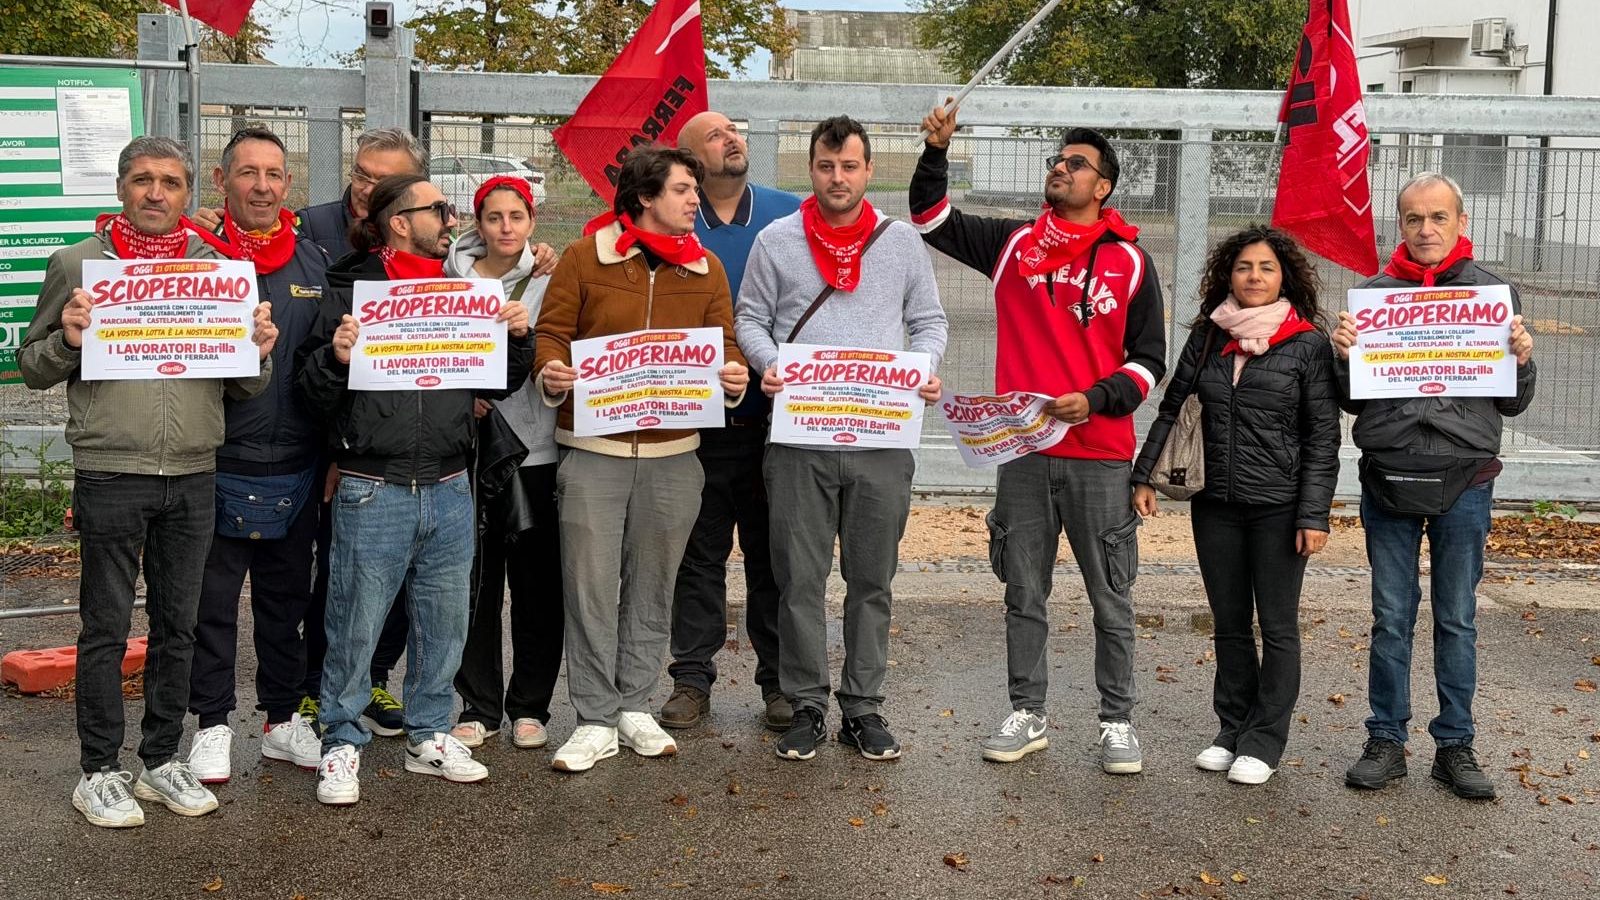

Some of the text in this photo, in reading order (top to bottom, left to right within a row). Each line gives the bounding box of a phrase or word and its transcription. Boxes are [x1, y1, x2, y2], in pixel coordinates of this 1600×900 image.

[22, 237, 66, 245] SICUREZZA
[92, 277, 250, 303] SCIOPERIAMO
[360, 295, 500, 323] SCIOPERIAMO
[1356, 303, 1508, 330] SCIOPERIAMO
[109, 343, 236, 354] I LAVORATORI Barilla
[373, 357, 484, 369] I LAVORATORI Barilla
[580, 344, 716, 378] SCIOPERIAMO
[784, 362, 921, 388] SCIOPERIAMO
[1373, 365, 1493, 376] I LAVORATORI Barilla
[602, 402, 668, 417] LAVORATORI
[672, 401, 702, 411] Barilla
[624, 411, 648, 419] MULINO
[860, 408, 882, 416] NOSTRA
[801, 417, 867, 428] LAVORATORI
[870, 421, 900, 431] Barilla
